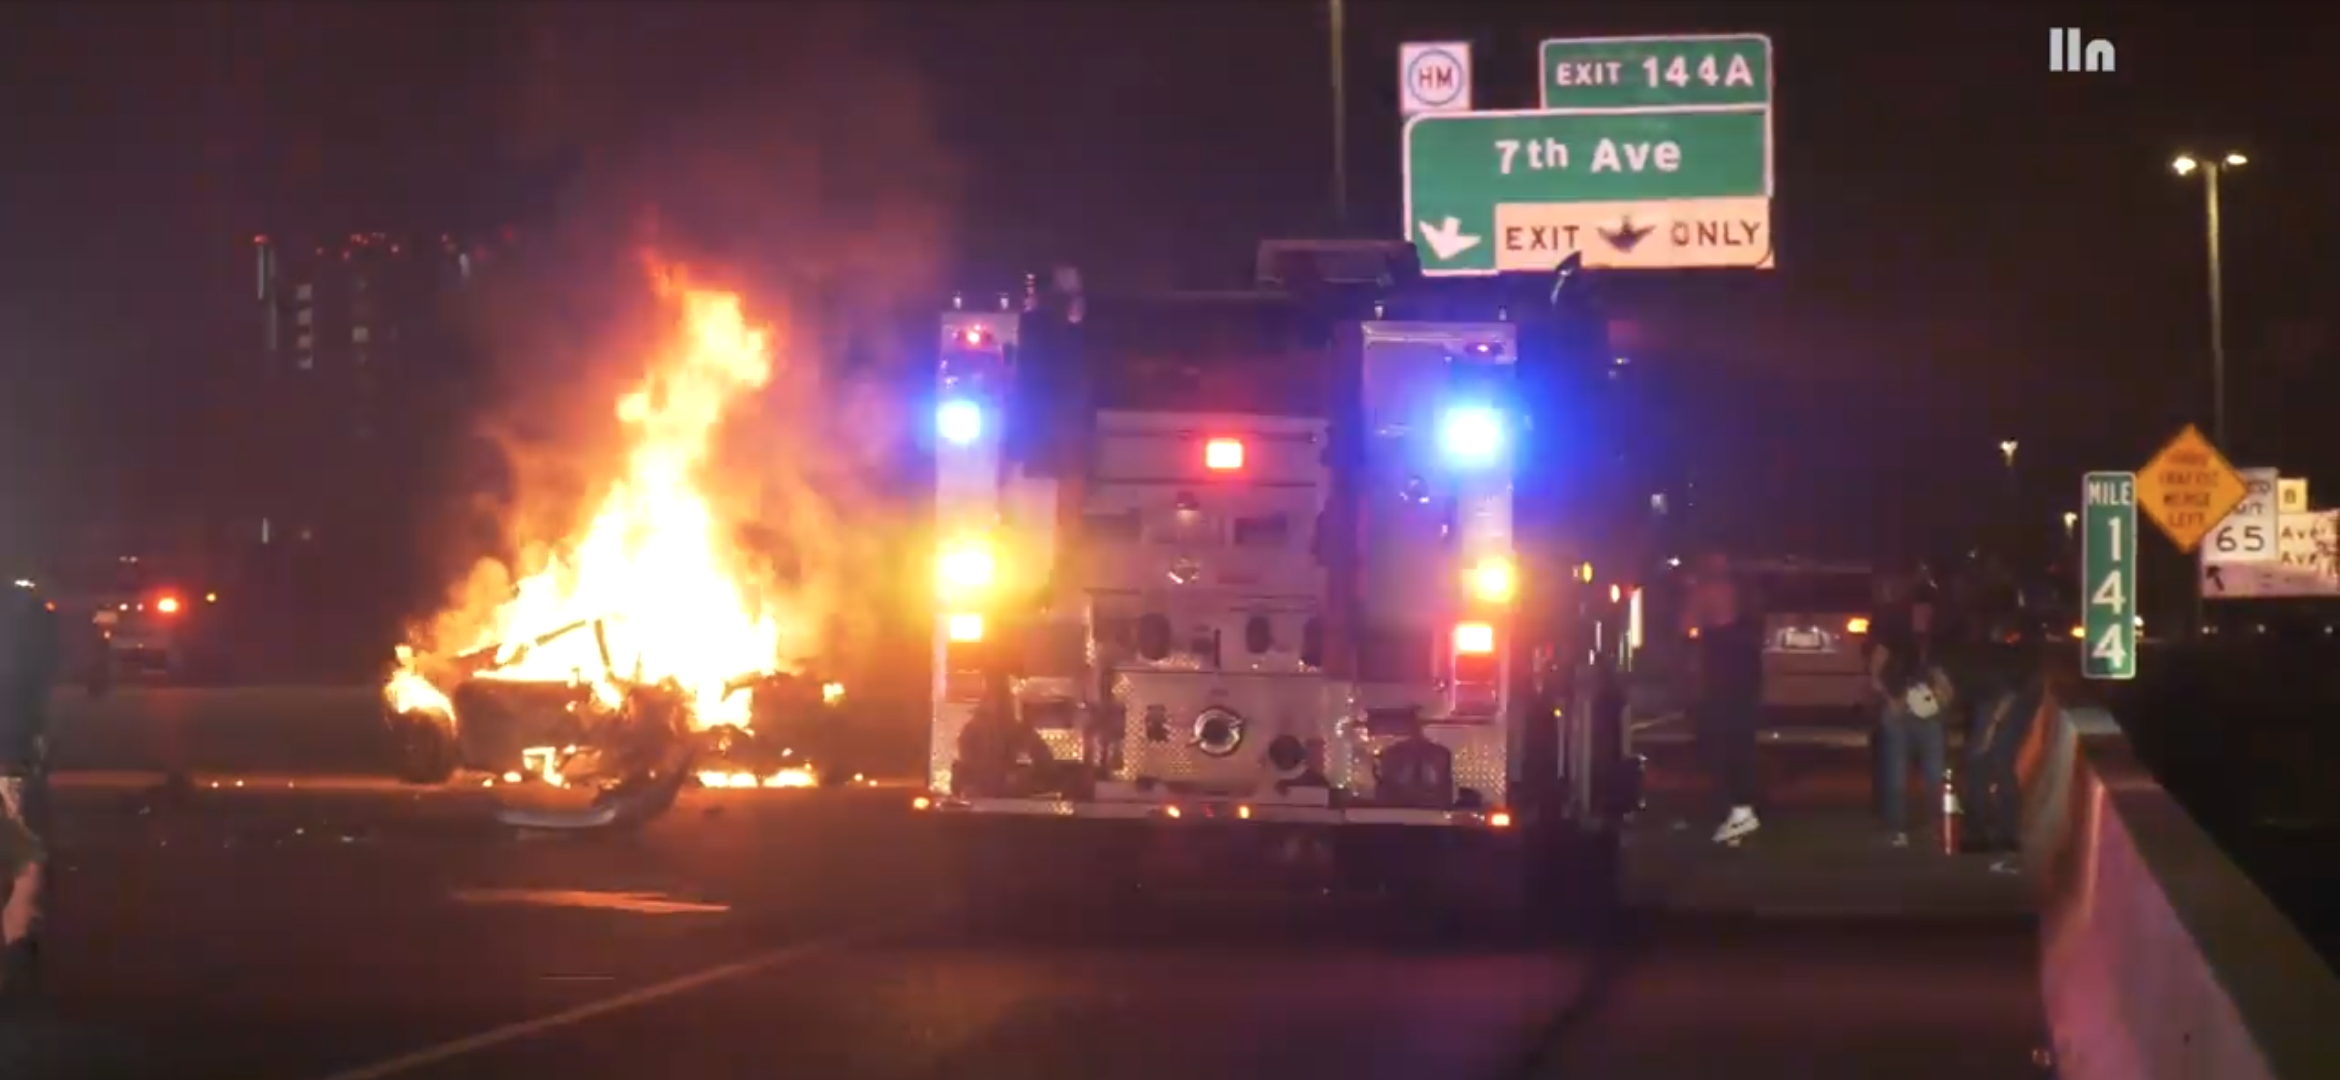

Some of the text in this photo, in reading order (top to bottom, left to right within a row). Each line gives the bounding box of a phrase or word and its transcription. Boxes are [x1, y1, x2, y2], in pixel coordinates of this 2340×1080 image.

[1418, 63, 1454, 89] HM
[1555, 53, 1755, 88] EXIT 144A
[1494, 137, 1682, 175] 7th Ave
[1505, 220, 1762, 251] EXIT ONLY
[2088, 481, 2133, 506] MILE
[2215, 525, 2266, 553] 65
